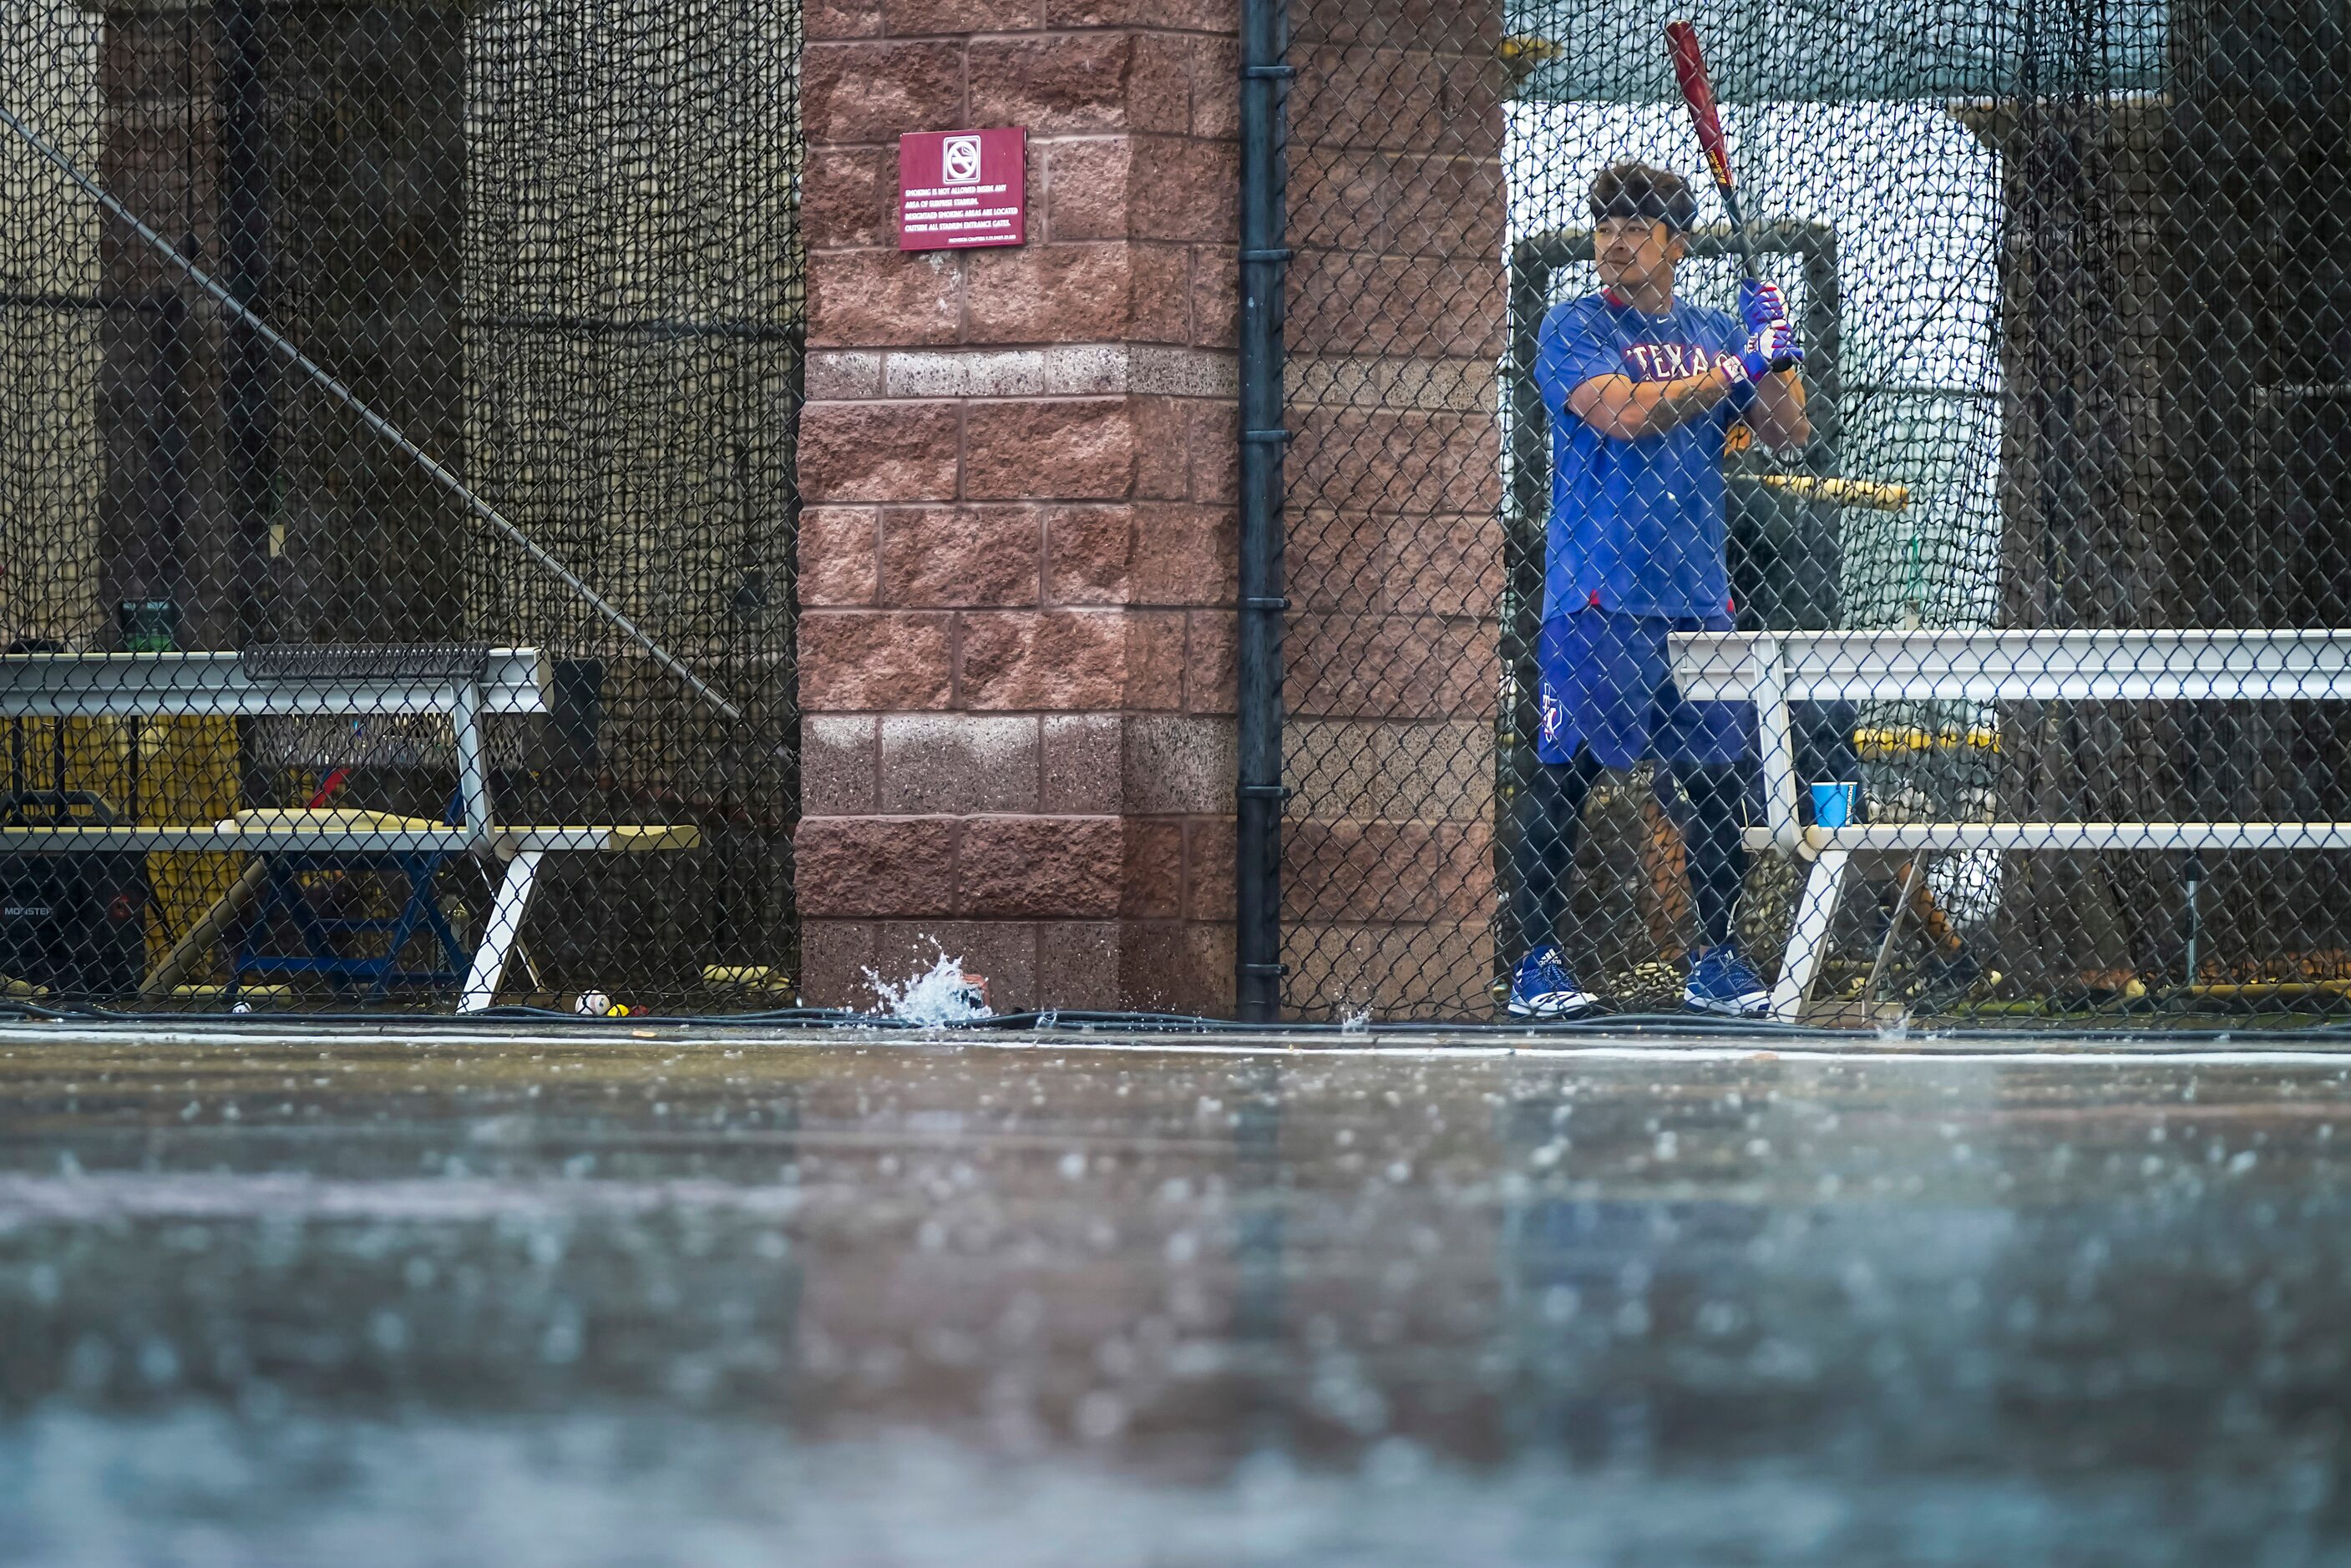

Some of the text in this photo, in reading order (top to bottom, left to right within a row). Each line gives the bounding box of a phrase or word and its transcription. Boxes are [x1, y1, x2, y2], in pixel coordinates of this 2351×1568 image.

[938, 187, 950, 195] NOT
[951, 185, 976, 195] ALLOWED
[976, 185, 994, 193] INSIDE
[995, 184, 1006, 192] ANY
[929, 199, 953, 207] SURPRISE
[954, 197, 979, 205] STADIUM.
[938, 210, 964, 219] SMOKING
[965, 209, 982, 217] AREAS
[994, 207, 1018, 215] LOCATED
[904, 224, 928, 232] OUTSIDE
[939, 221, 963, 230] STADIUM
[964, 220, 991, 229] ENTRANCE
[992, 219, 1011, 227] GATES.
